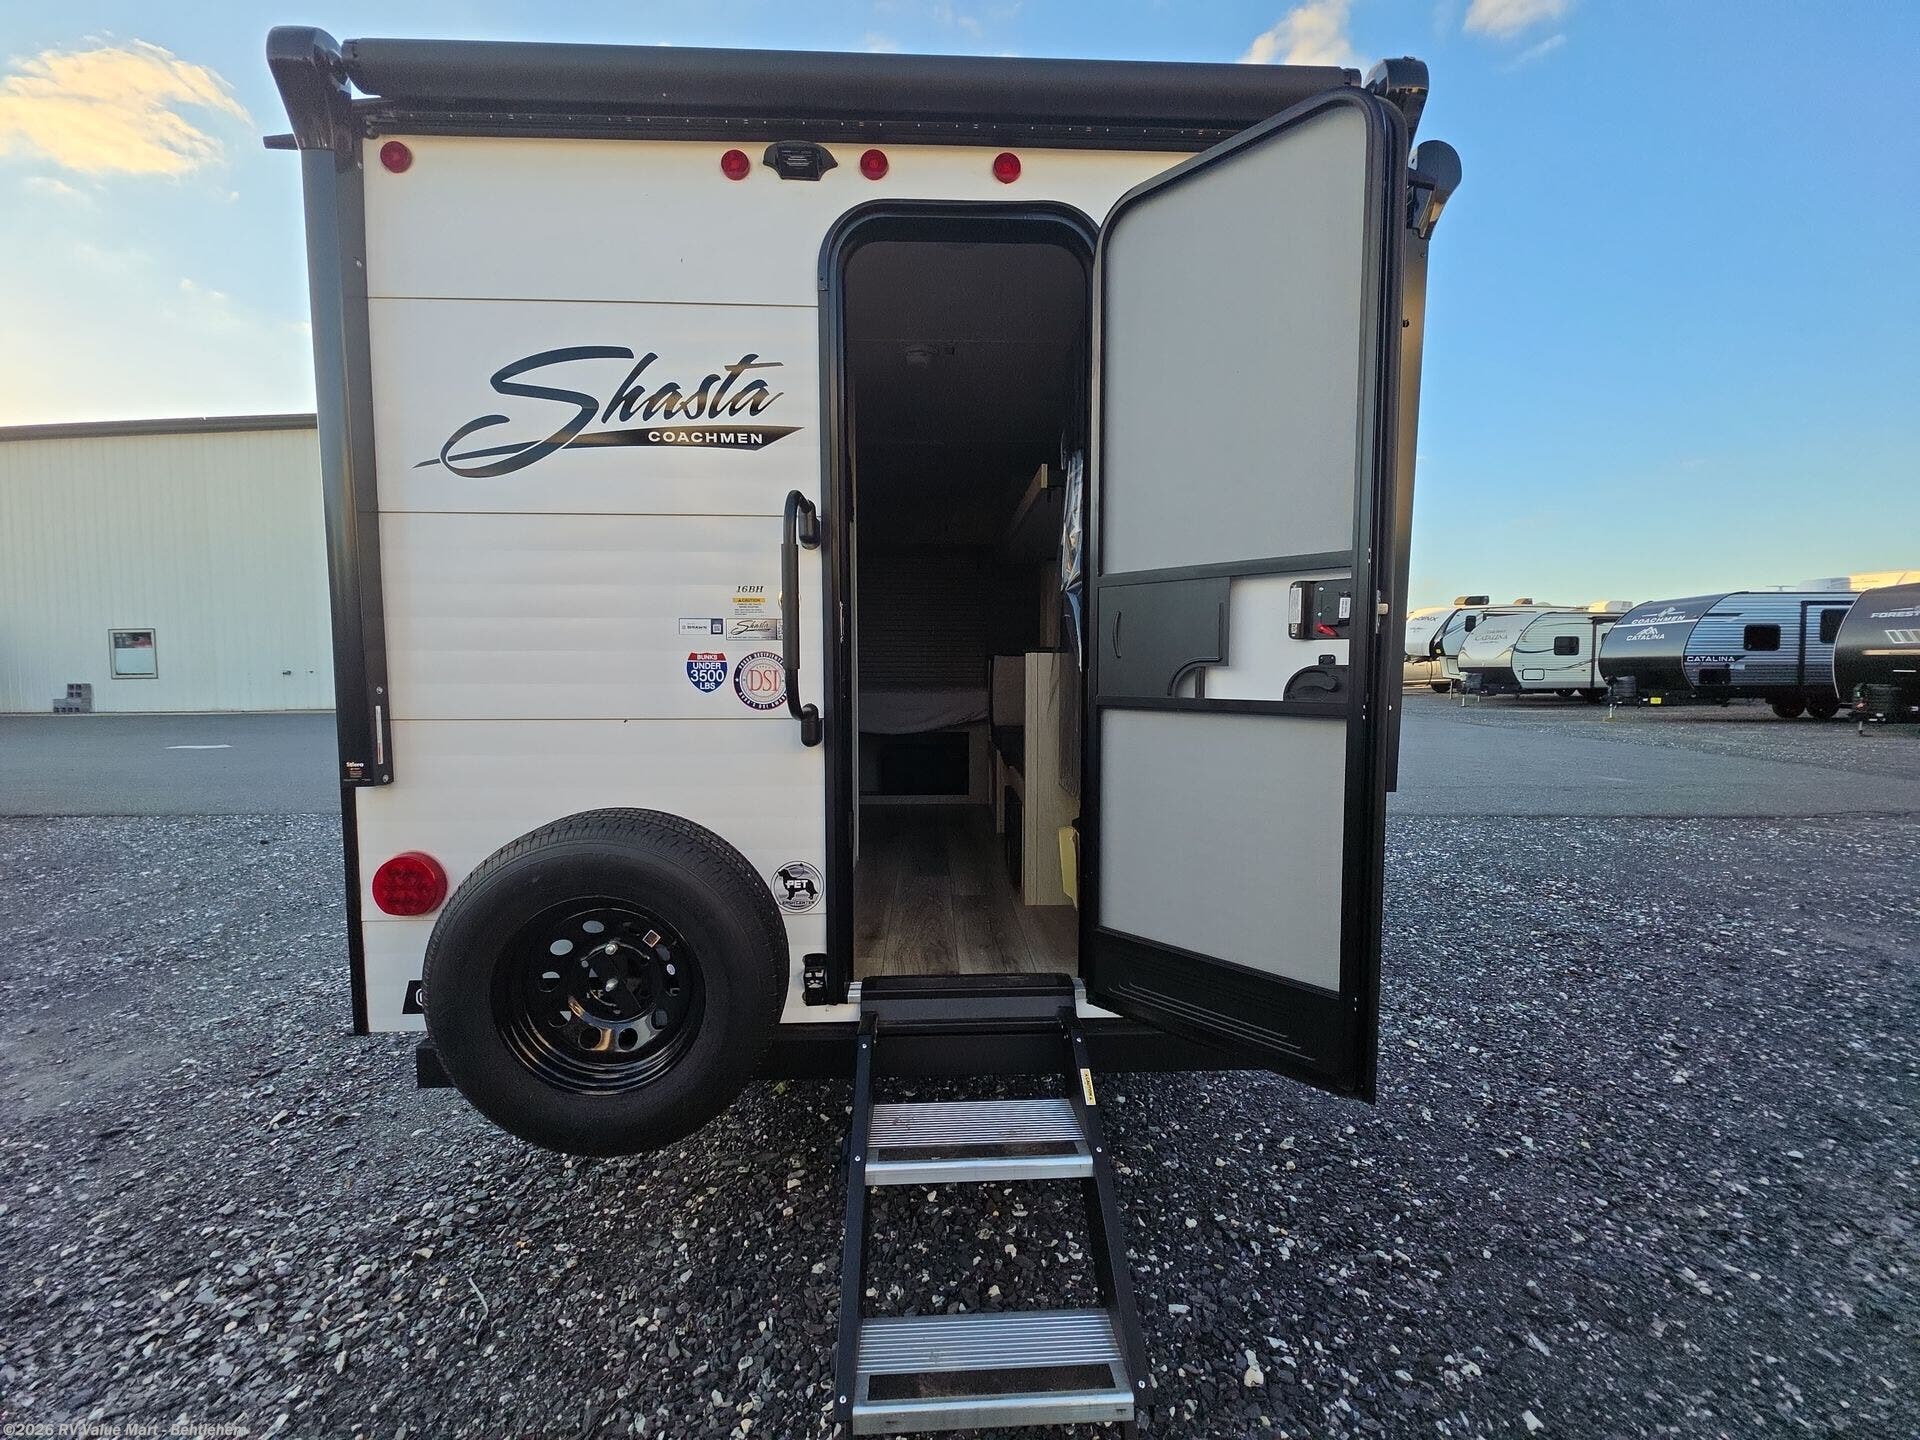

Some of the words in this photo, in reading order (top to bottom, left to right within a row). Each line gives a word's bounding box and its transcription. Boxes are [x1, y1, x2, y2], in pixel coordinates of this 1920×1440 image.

[440, 345, 784, 479] Shasta
[647, 430, 764, 445] COACHMEN
[737, 585, 764, 593] 16BH
[1631, 615, 1686, 625] COACHMEN
[1626, 633, 1665, 641] CATALINA
[693, 662, 721, 670] UNDER
[691, 670, 724, 682] 3500
[749, 669, 779, 691] DSI
[700, 682, 715, 690] LBS
[786, 879, 809, 889] PET
